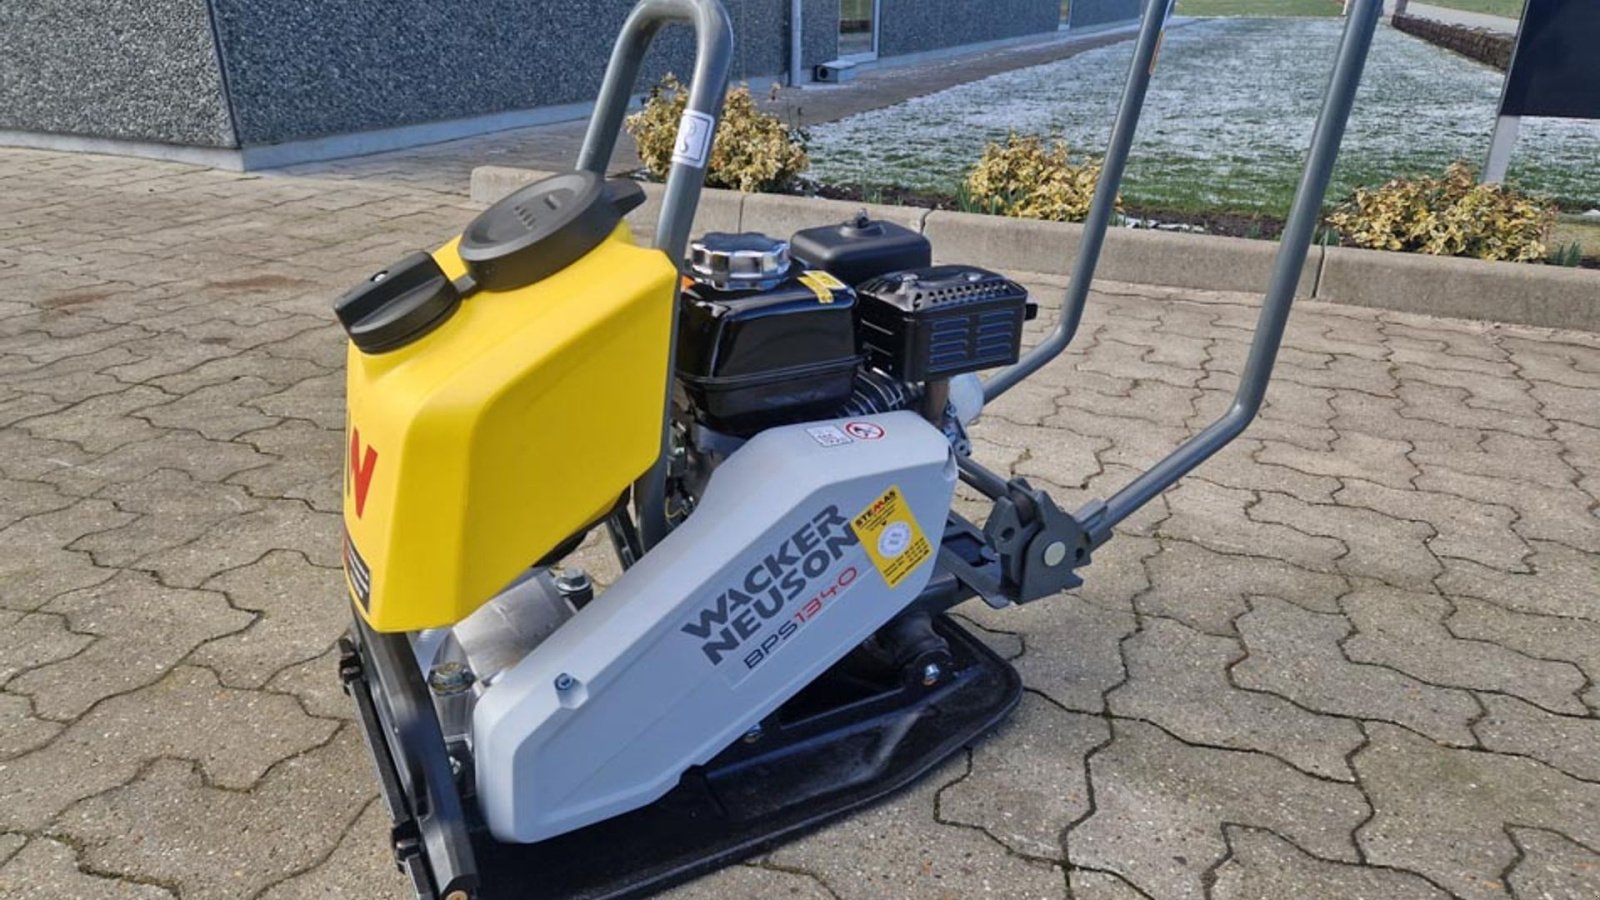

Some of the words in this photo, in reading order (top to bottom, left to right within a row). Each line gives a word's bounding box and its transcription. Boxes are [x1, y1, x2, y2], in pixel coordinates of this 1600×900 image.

[855, 489, 897, 527] STEMAS
[681, 504, 848, 639] WACKER
[701, 521, 861, 667] NEUSON
[743, 566, 858, 669] BPS1340
